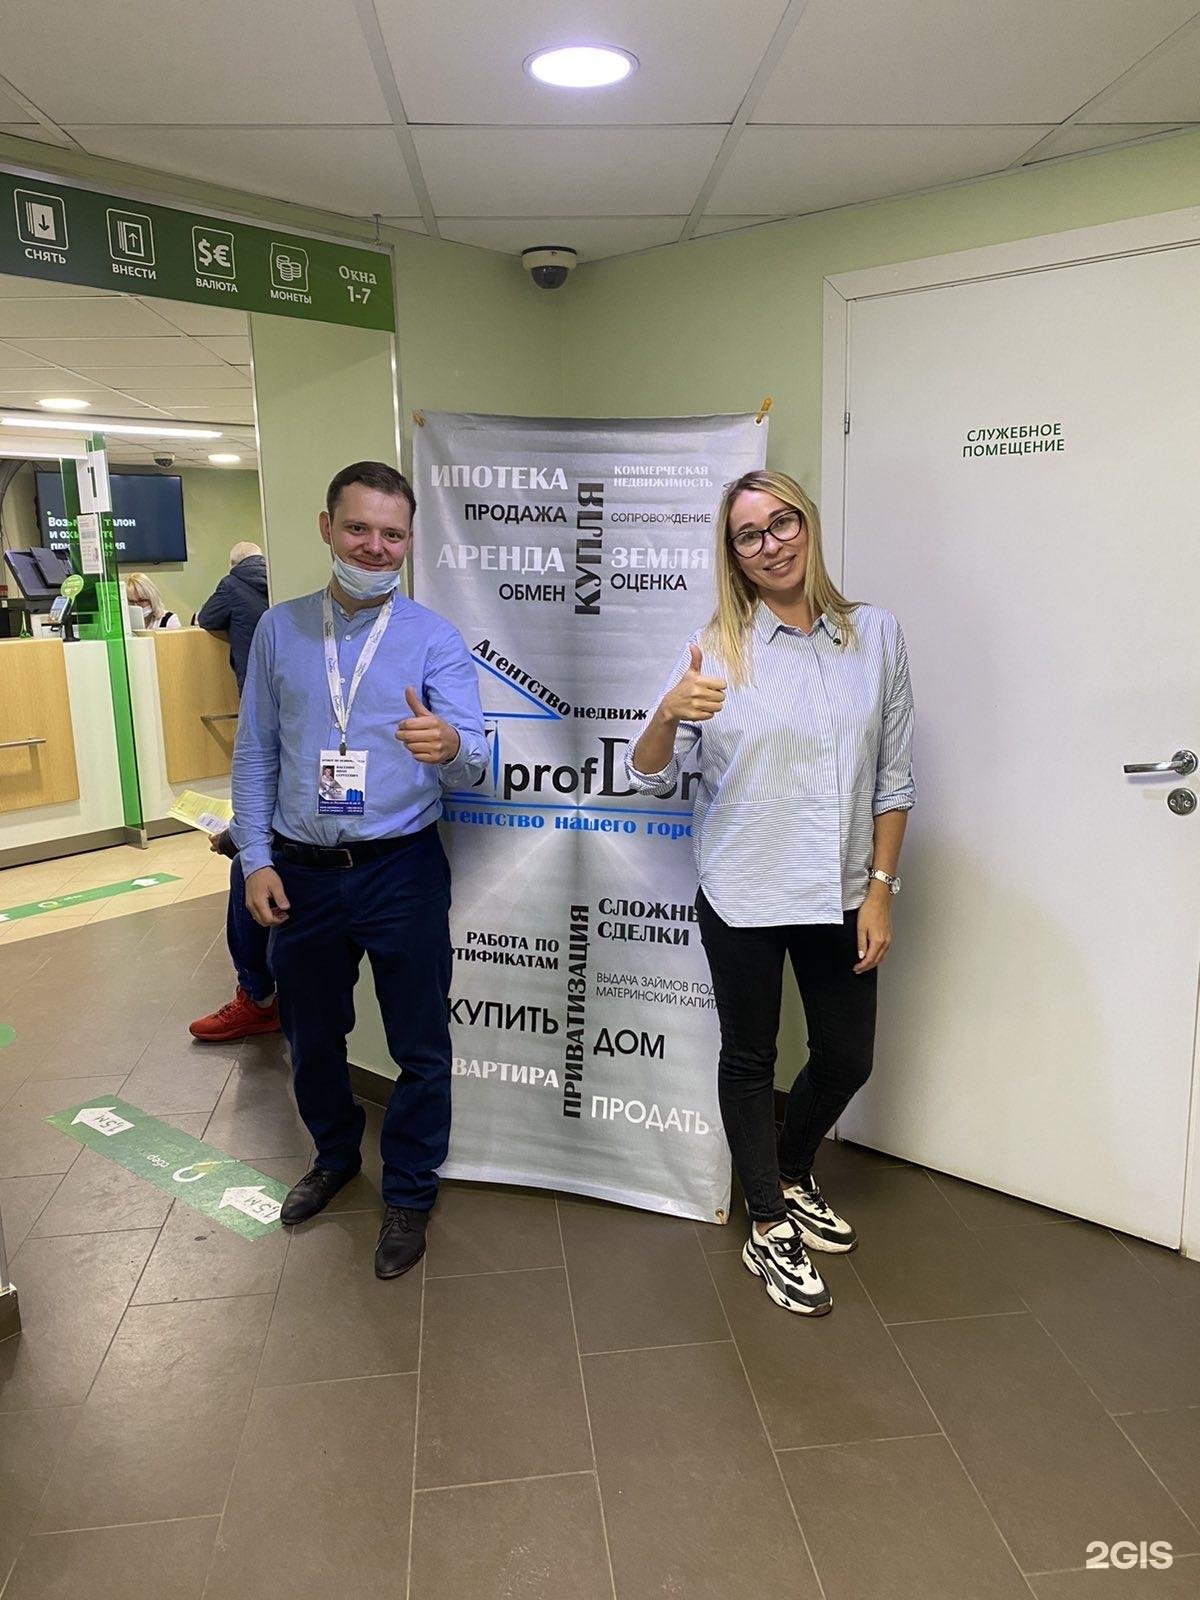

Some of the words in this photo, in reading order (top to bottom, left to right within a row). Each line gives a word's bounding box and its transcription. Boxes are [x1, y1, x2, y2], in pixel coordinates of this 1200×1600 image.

[24, 247, 67, 265] СНЯТЬ
[112, 263, 157, 280] ВНЕСТИ
[338, 265, 377, 286] Окна
[195, 277, 239, 293] ВАЛЮТА
[270, 290, 312, 304] МОНЕТЫ
[346, 286, 372, 305] 1-7
[967, 423, 1062, 442] СЛУЖЕБНОЕ
[963, 439, 1065, 457] ПОМЕЩЕНИЕ
[430, 464, 568, 490] ИПОТЕКА
[613, 465, 709, 477] КОММЕРЧЕСКАЯ
[613, 477, 713, 489] НЕДВИЖИМОСТЬ
[464, 503, 567, 525] ПРОДАЖА
[611, 513, 711, 525] СОПРОВОЖДЕНИЕ
[574, 482, 605, 615] КУПЛЯ
[611, 546, 710, 570] ЗЕМЛЯ
[436, 544, 566, 576] АРЕНДА
[499, 583, 566, 602] ОБМЕН
[610, 573, 687, 593] ОЦЕНКА
[472, 638, 571, 716] Агентство
[555, 815, 636, 834] нашего
[466, 931, 528, 950] РАБОТА
[535, 938, 560, 953] ПО
[597, 921, 690, 946] СДЕЛКИ
[596, 973, 639, 986] ВЫДАЧА
[641, 976, 689, 992] ЗАЙМОВ
[596, 986, 677, 1005] МАТЕРИНСКИЙ
[680, 995, 717, 1010] КАПИТ
[448, 998, 559, 1035] КУПИТЬ
[563, 904, 590, 1119] ПРИВАТИЗАЦИЯ
[593, 1027, 665, 1060] ДОМ
[591, 1095, 710, 1136] ПРОДАТЬ
